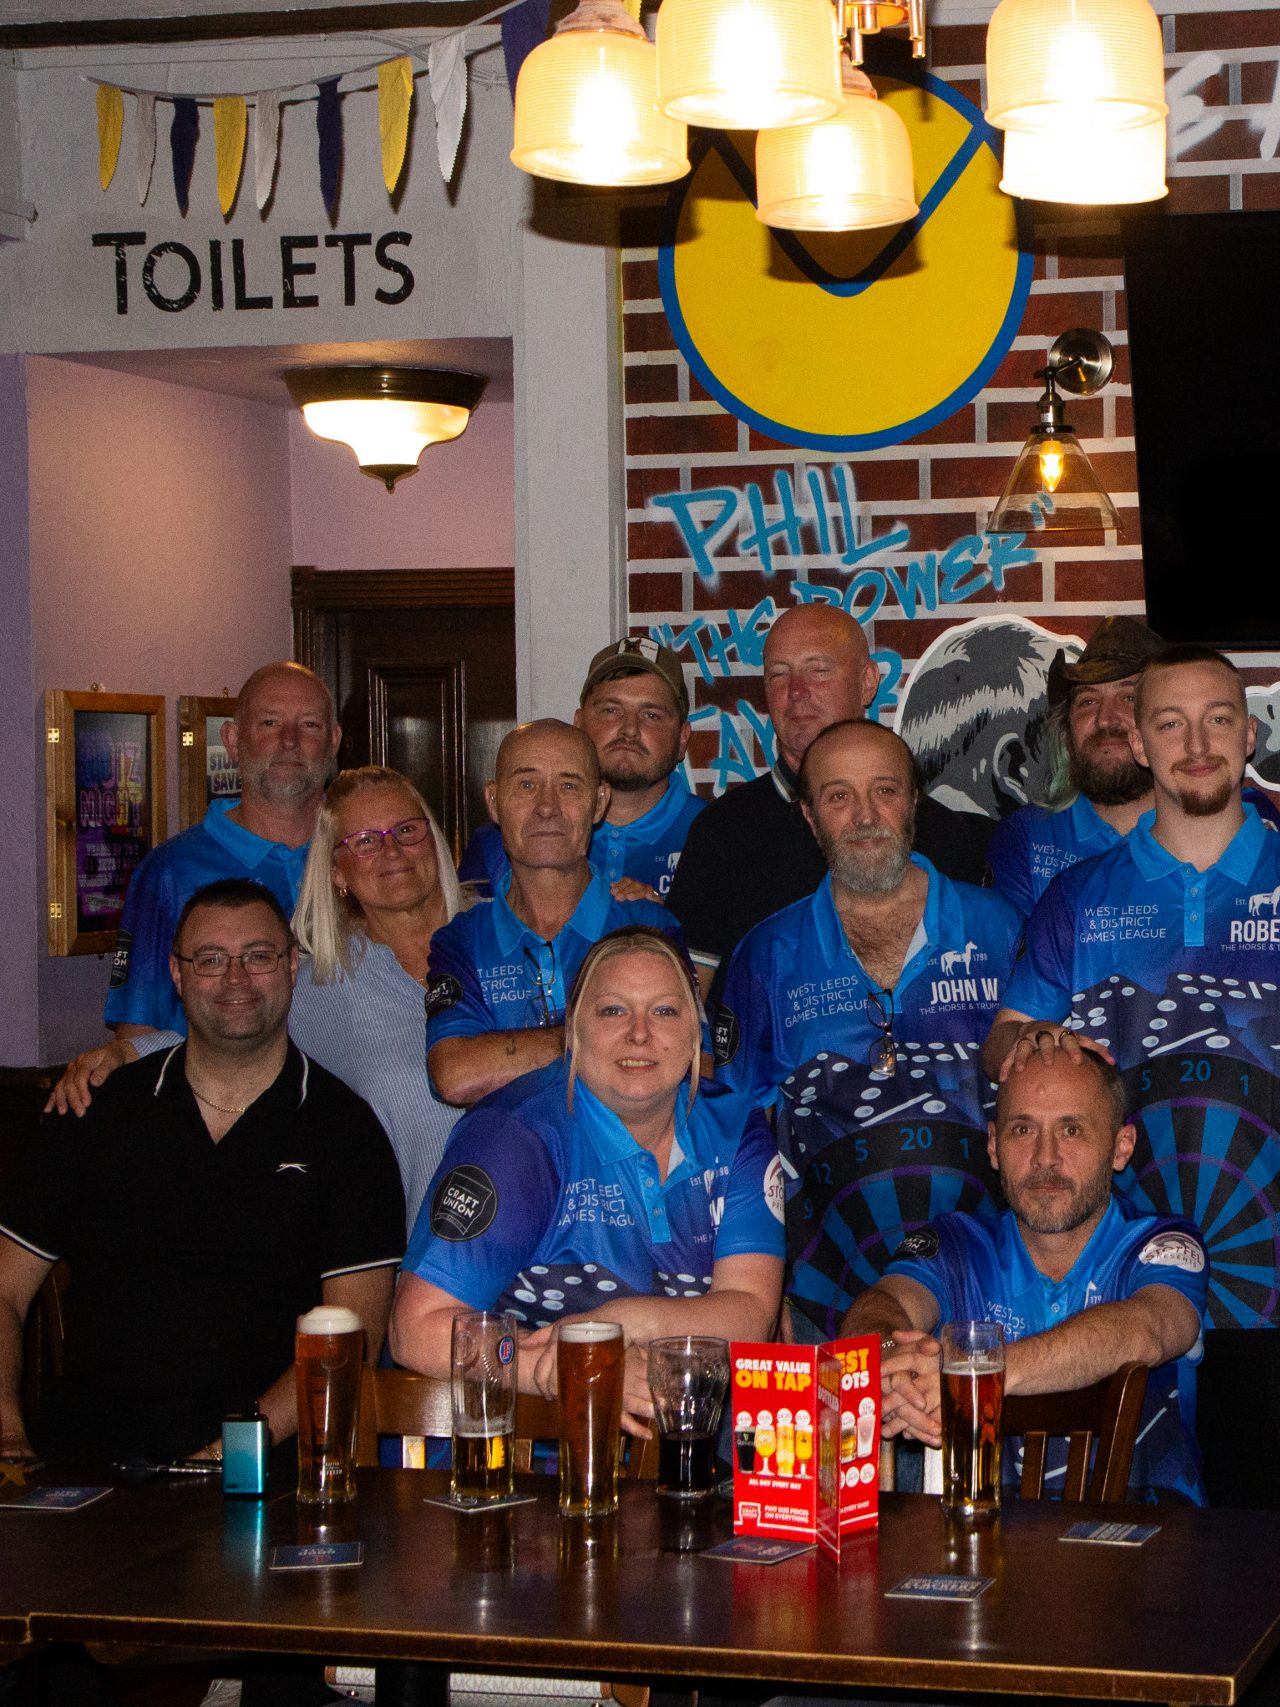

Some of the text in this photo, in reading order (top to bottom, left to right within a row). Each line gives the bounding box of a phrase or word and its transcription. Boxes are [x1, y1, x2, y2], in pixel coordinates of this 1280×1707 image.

[92, 231, 416, 314] TOILETS
[650, 462, 910, 582] PHIL
[1084, 904, 1159, 917] WEST LEEDS
[1089, 916, 1153, 929] & DISTRICT
[1080, 928, 1167, 943] GAMES LEAGUE
[1220, 943, 1236, 952] THE
[1238, 943, 1266, 951] HORSE
[1268, 943, 1275, 951] &
[486, 965, 524, 978] LEEDS
[787, 975, 859, 1000] WEST LEEDS
[930, 978, 998, 1005] JOHN W
[793, 988, 854, 1011] & DISTRICT
[919, 1006, 936, 1016] THE
[938, 1003, 966, 1012] HORSE
[785, 998, 869, 1028] GAMES LEAGUE
[1139, 1069, 1151, 1092] 5
[1179, 1058, 1212, 1083] 20
[1240, 1074, 1249, 1096] 1
[900, 1126, 934, 1151] 20
[961, 1136, 970, 1159] 1
[854, 1138, 869, 1163] 5
[810, 1161, 833, 1185] 12
[443, 1196, 475, 1219] UNION
[447, 1187, 480, 1209] CRAFT
[567, 1198, 576, 1211] &
[693, 1234, 707, 1244] THE
[735, 1358, 811, 1374] GREAT VALUE
[735, 1369, 812, 1392] ON TAP
[748, 1478, 759, 1486] ALL
[790, 1482, 802, 1491] DAY
[774, 1513, 809, 1523] EVERYTHING
[790, 1507, 809, 1516] PRICES
